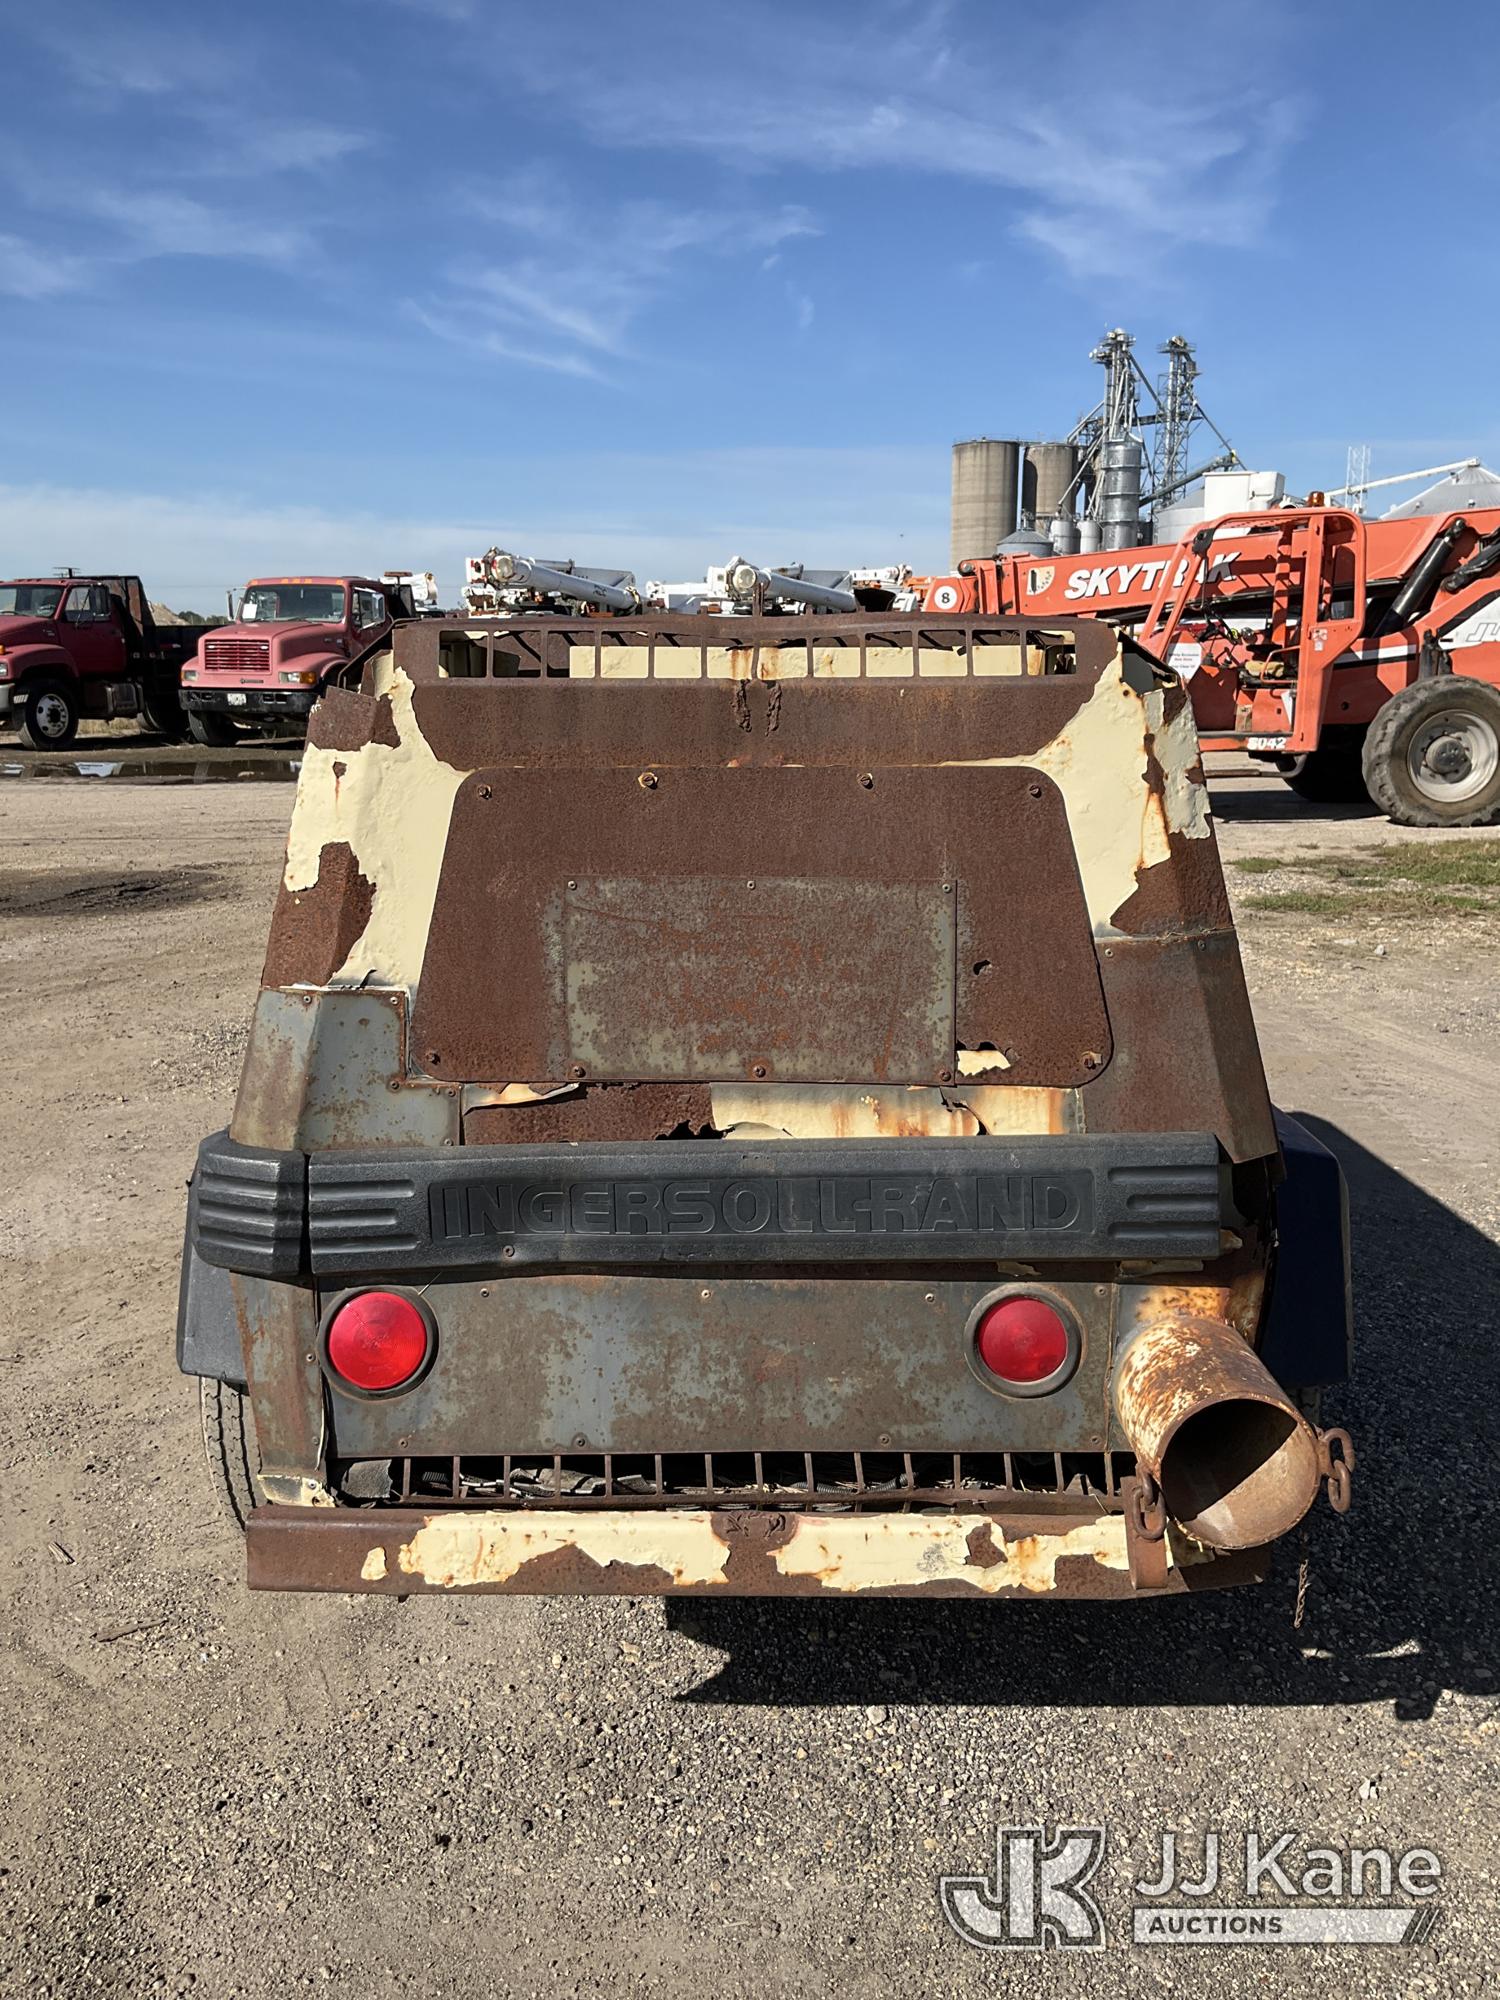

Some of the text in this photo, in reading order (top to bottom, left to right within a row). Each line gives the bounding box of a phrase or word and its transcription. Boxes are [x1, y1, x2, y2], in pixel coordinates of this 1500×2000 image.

[941, 592, 950, 603] 8
[1465, 622, 1500, 642] JL
[442, 1176, 1081, 1238] INGERSOLL-RAND
